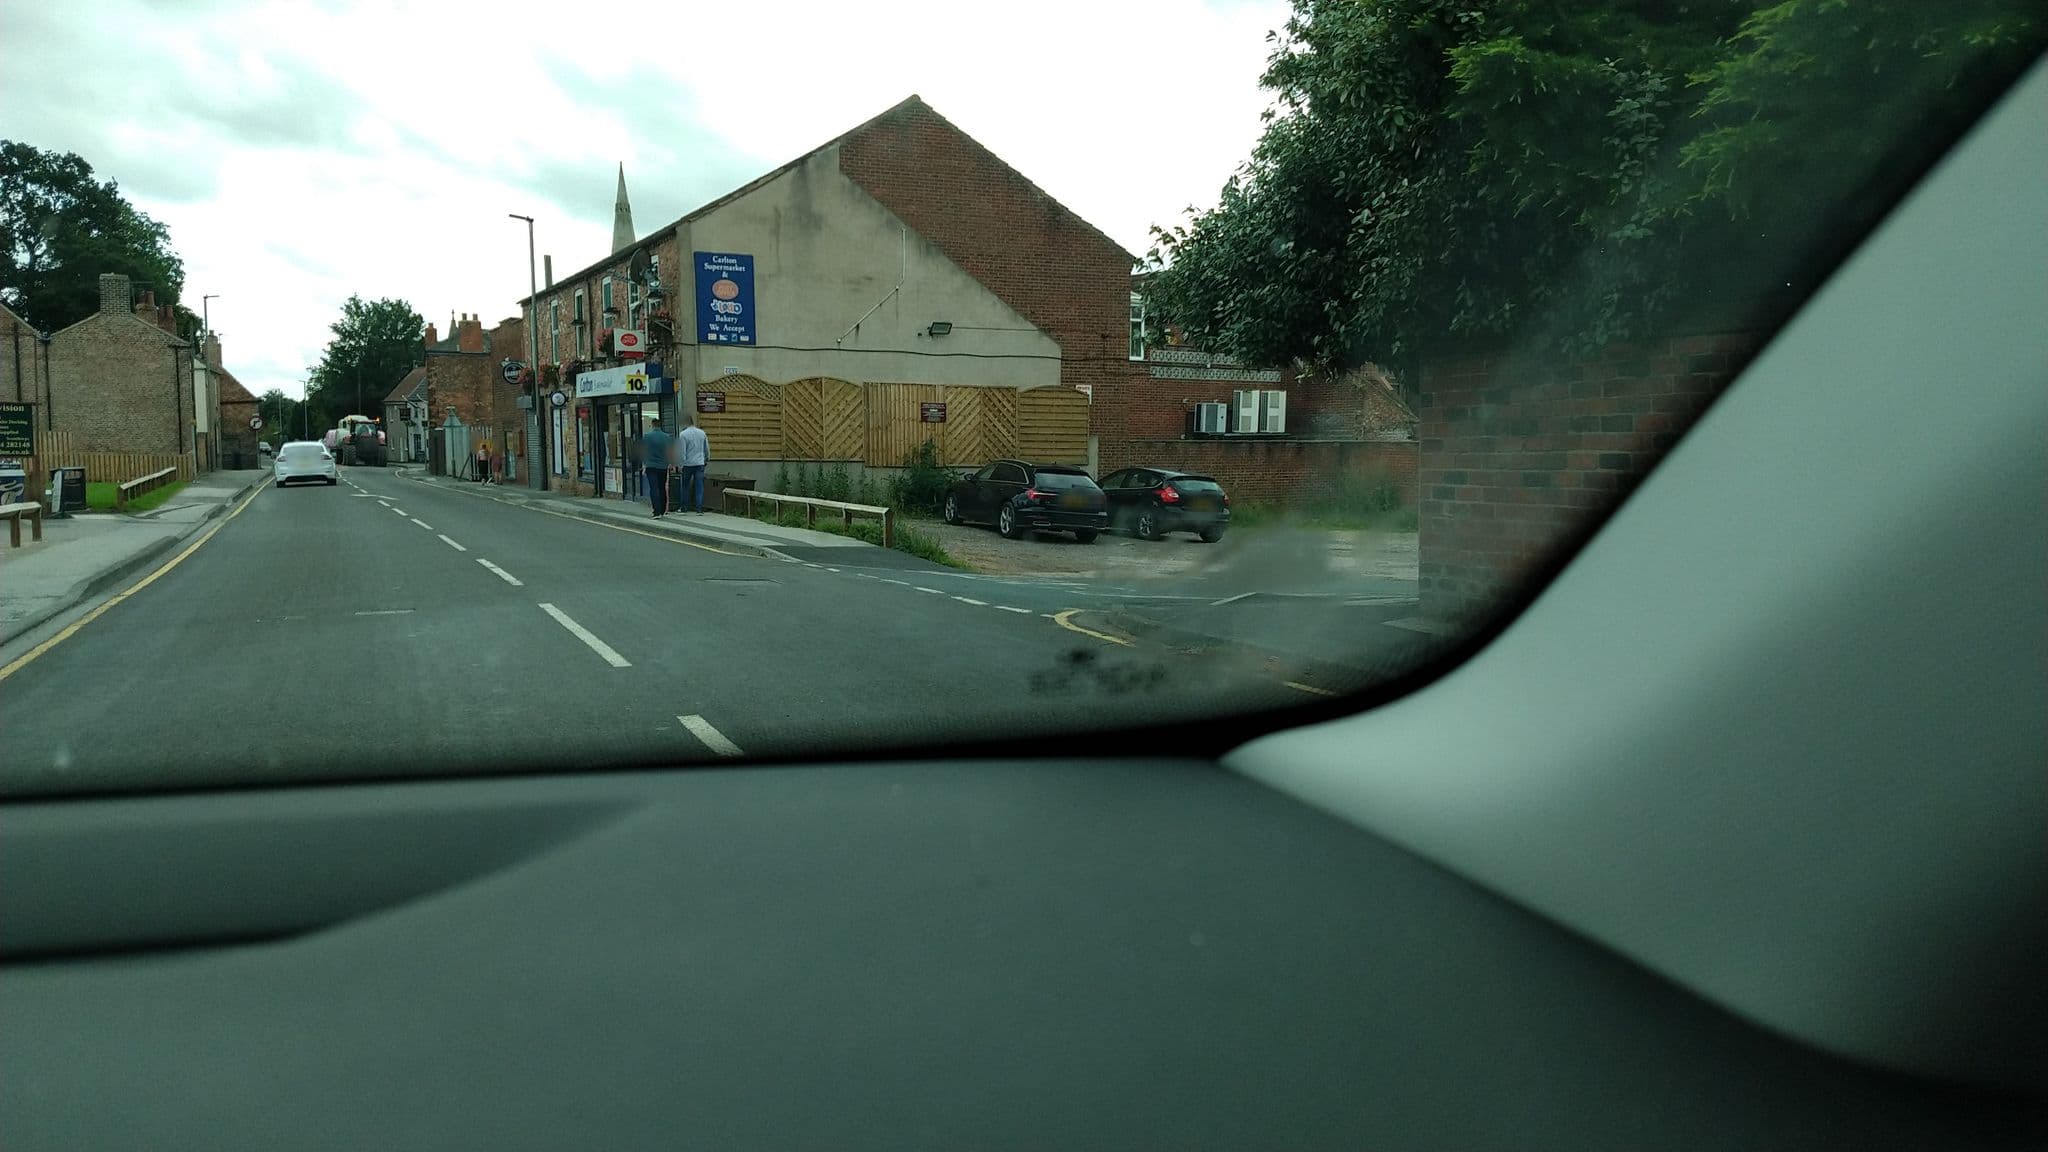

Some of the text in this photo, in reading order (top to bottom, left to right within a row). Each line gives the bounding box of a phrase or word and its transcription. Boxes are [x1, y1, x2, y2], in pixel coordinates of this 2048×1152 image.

[712, 255, 737, 264] Carlton
[704, 262, 746, 272] Supermarket
[715, 314, 738, 324] Bakery
[709, 323, 745, 333] We Accept
